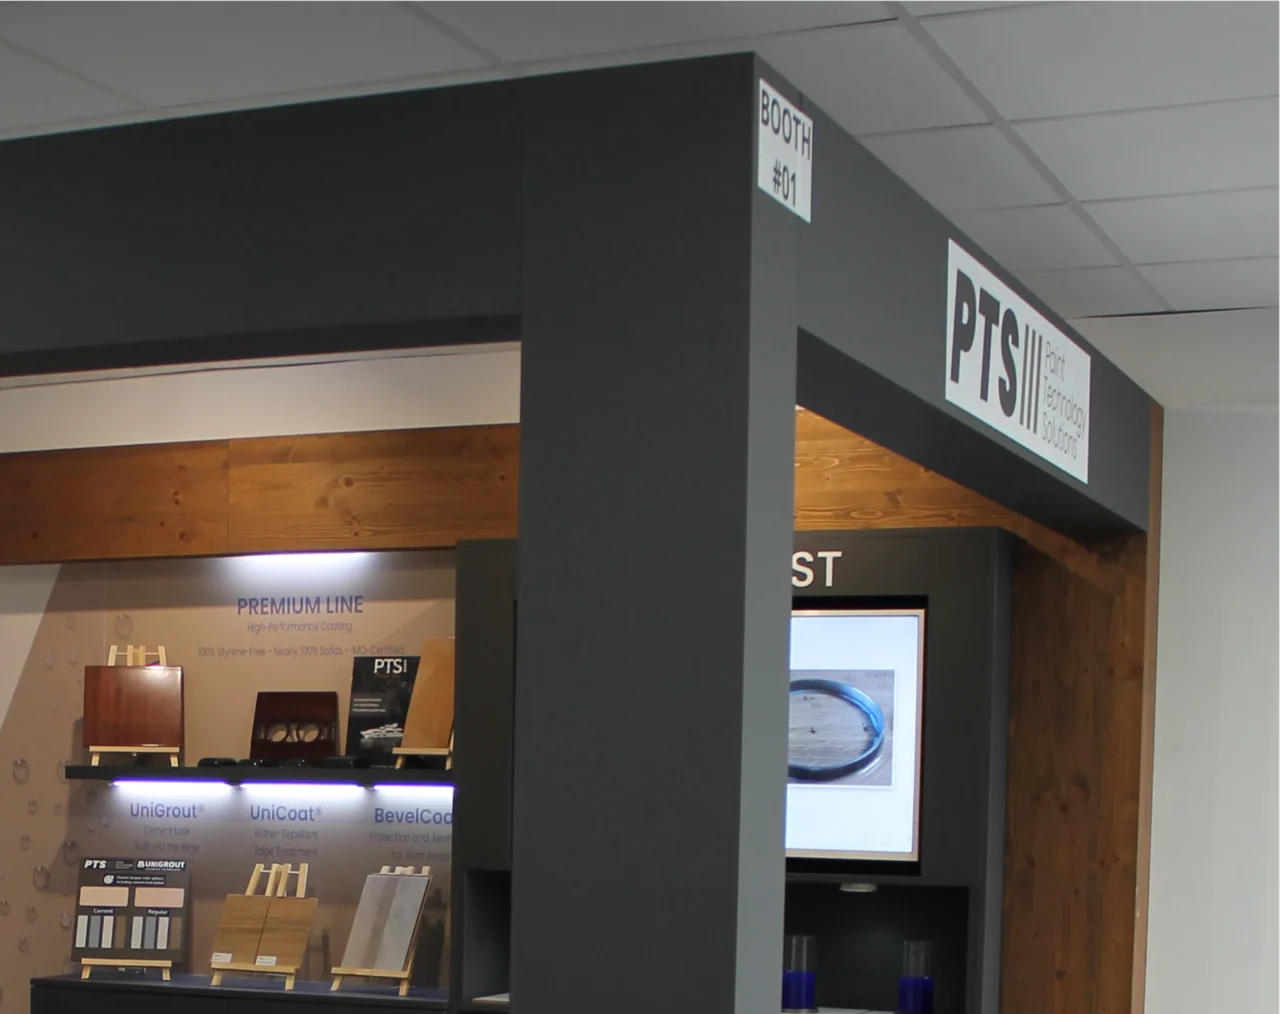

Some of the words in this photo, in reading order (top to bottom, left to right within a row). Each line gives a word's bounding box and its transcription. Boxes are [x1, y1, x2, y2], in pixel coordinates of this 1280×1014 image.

[761, 89, 811, 160] BOOTH
[773, 159, 796, 207] #01
[950, 268, 1019, 418] PTS
[1046, 341, 1065, 382] Paint
[1044, 376, 1087, 440] Technology
[1042, 412, 1077, 460] Solutions
[237, 596, 320, 615] PREMIUM
[326, 595, 363, 613] LINE
[247, 622, 319, 635] High-Performance
[321, 621, 352, 633] Coating
[375, 808, 453, 824] BevelCoa
[84, 860, 107, 869] PTS
